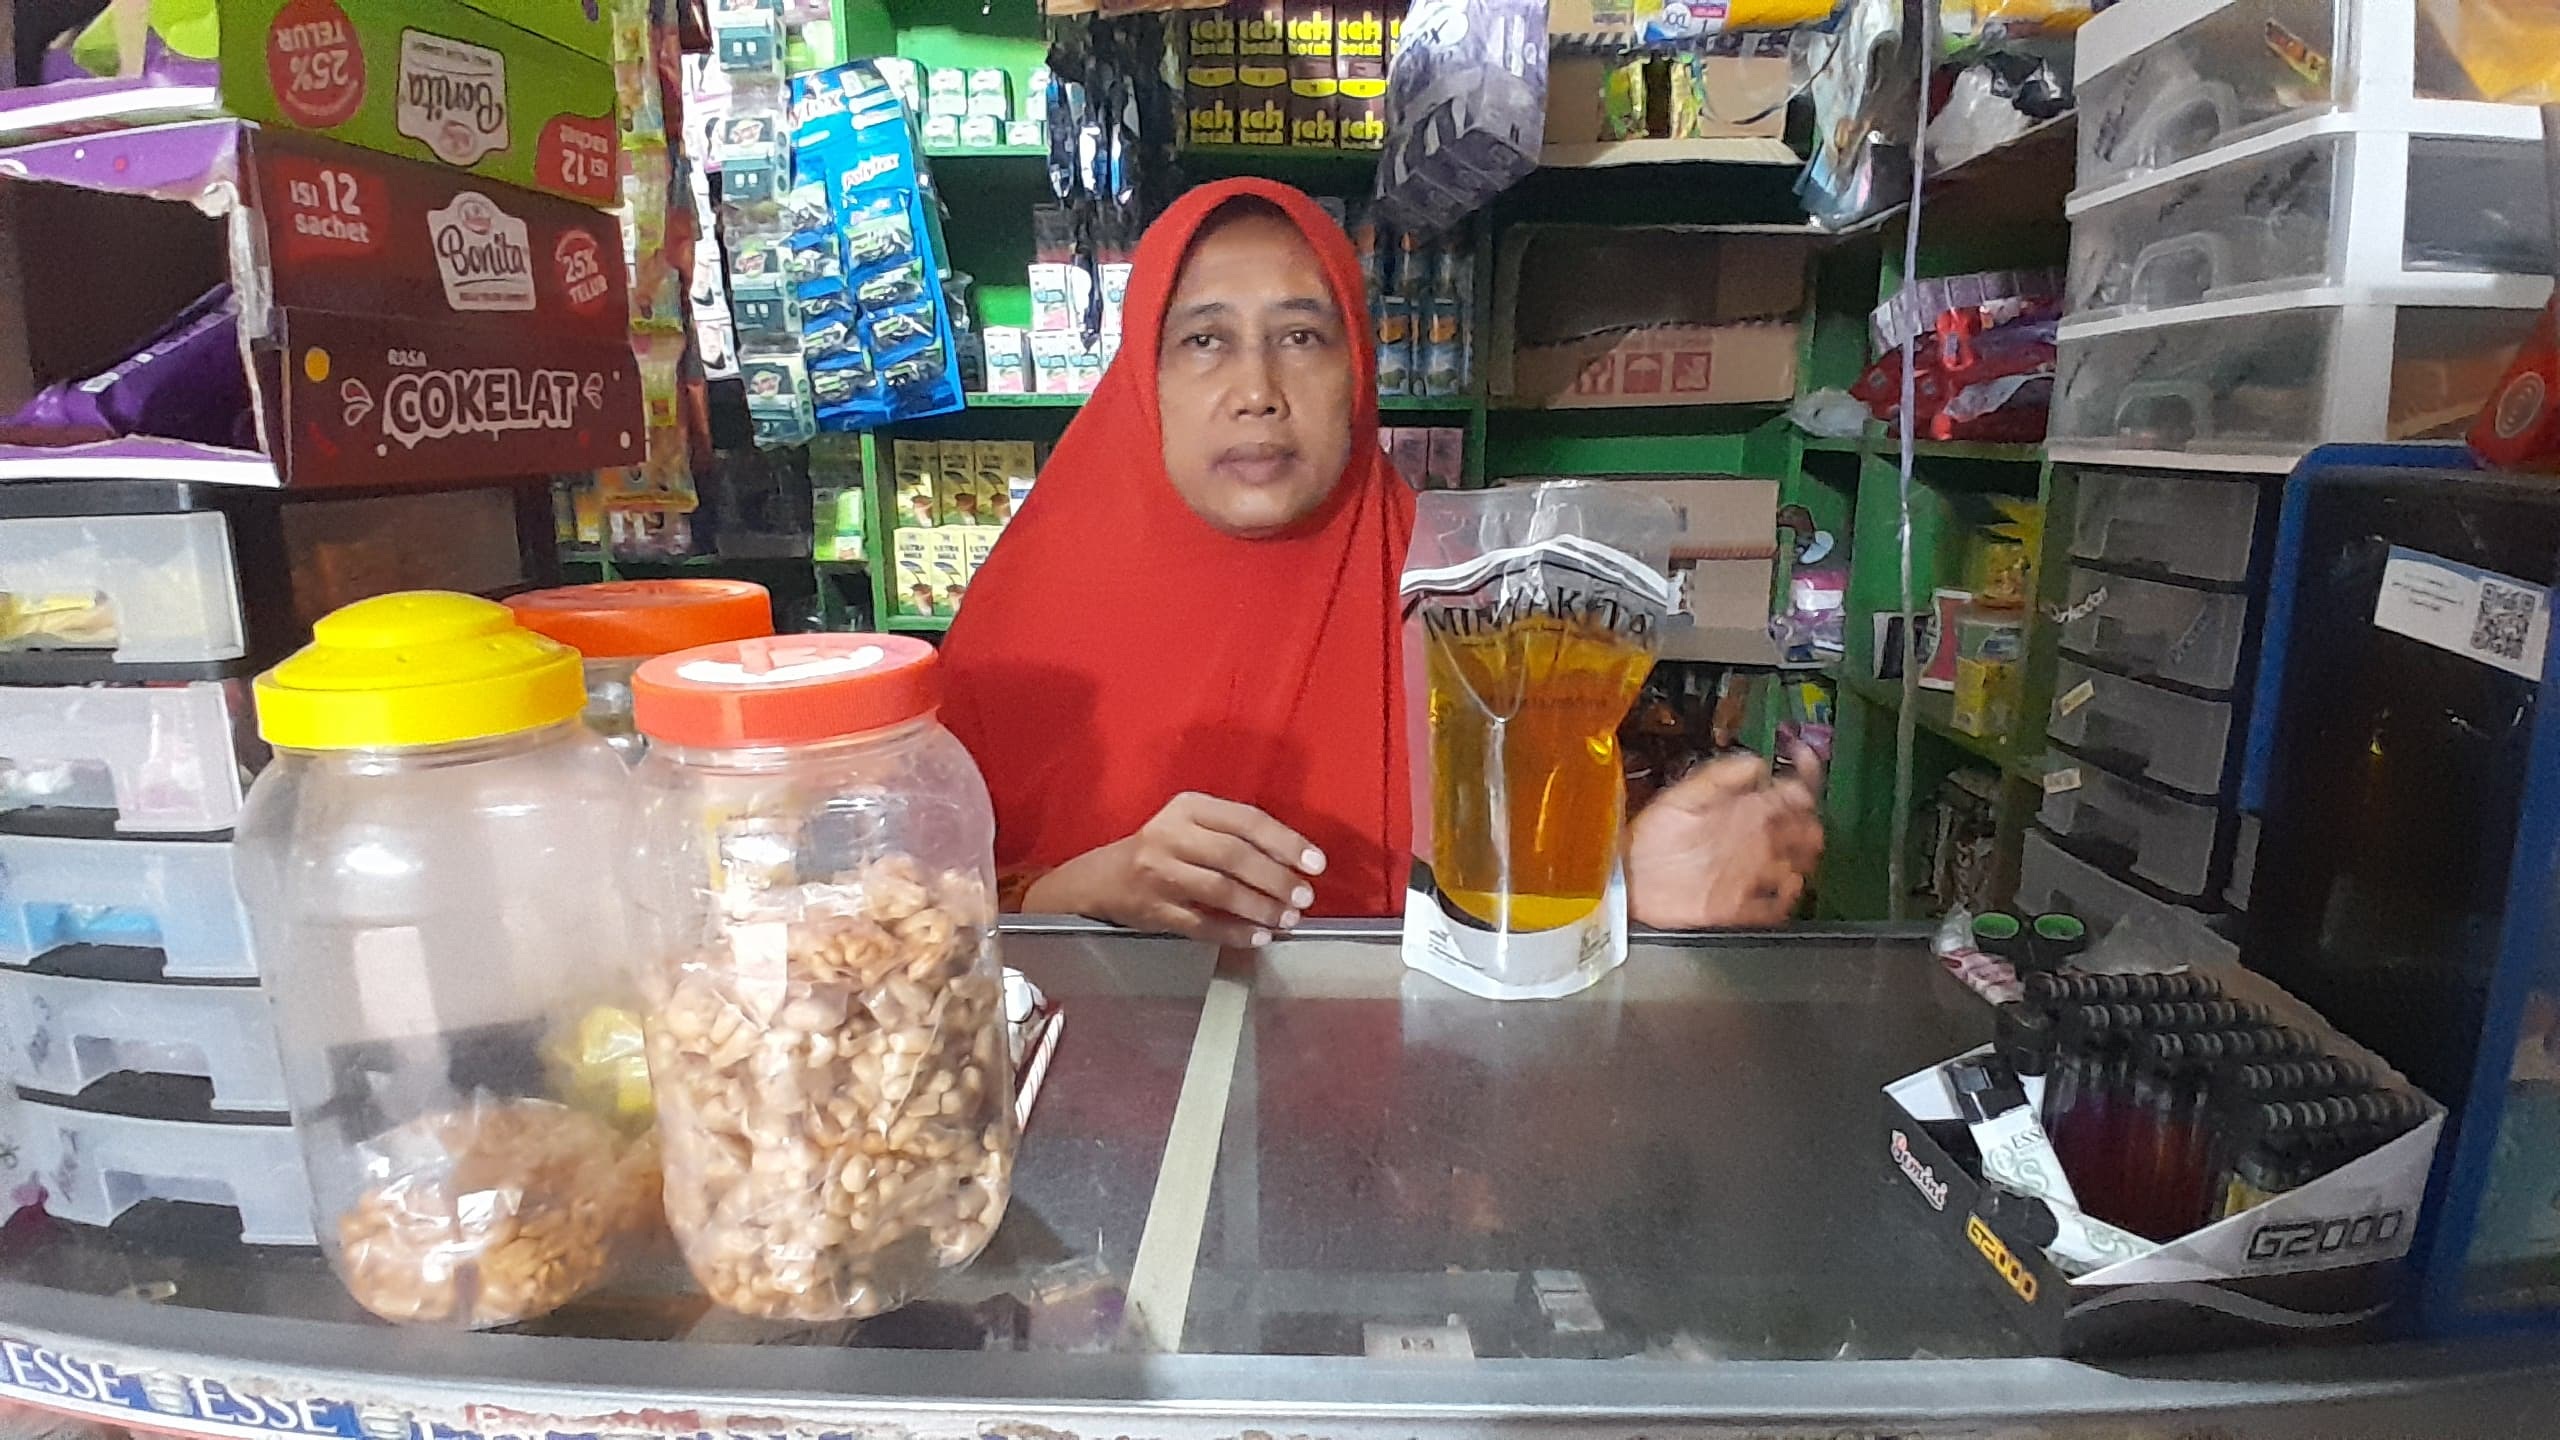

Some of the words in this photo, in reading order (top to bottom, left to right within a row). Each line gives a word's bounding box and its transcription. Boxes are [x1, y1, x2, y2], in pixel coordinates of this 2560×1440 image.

[278, 21, 346, 51] TELUR
[1288, 11, 1332, 41] teh
[1338, 11, 1382, 41] teh
[290, 49, 349, 92] 25%
[408, 73, 503, 133] Bonita
[1240, 99, 1284, 129] teh
[1340, 110, 1383, 139] teh
[561, 149, 587, 185] 12
[291, 180, 318, 207] ISI
[320, 170, 361, 215] 12
[295, 214, 370, 243] sachet
[438, 225, 526, 276] Bonita
[562, 249, 599, 283] 25%
[569, 274, 608, 304] TELUR
[387, 349, 427, 368] RASA
[384, 369, 578, 440] COKELAT
[2247, 1210, 2403, 1260] G2000
[1967, 1213, 2038, 1302] G2000
[3, 1341, 130, 1407] ESSE
[191, 1376, 338, 1433] ESSE
